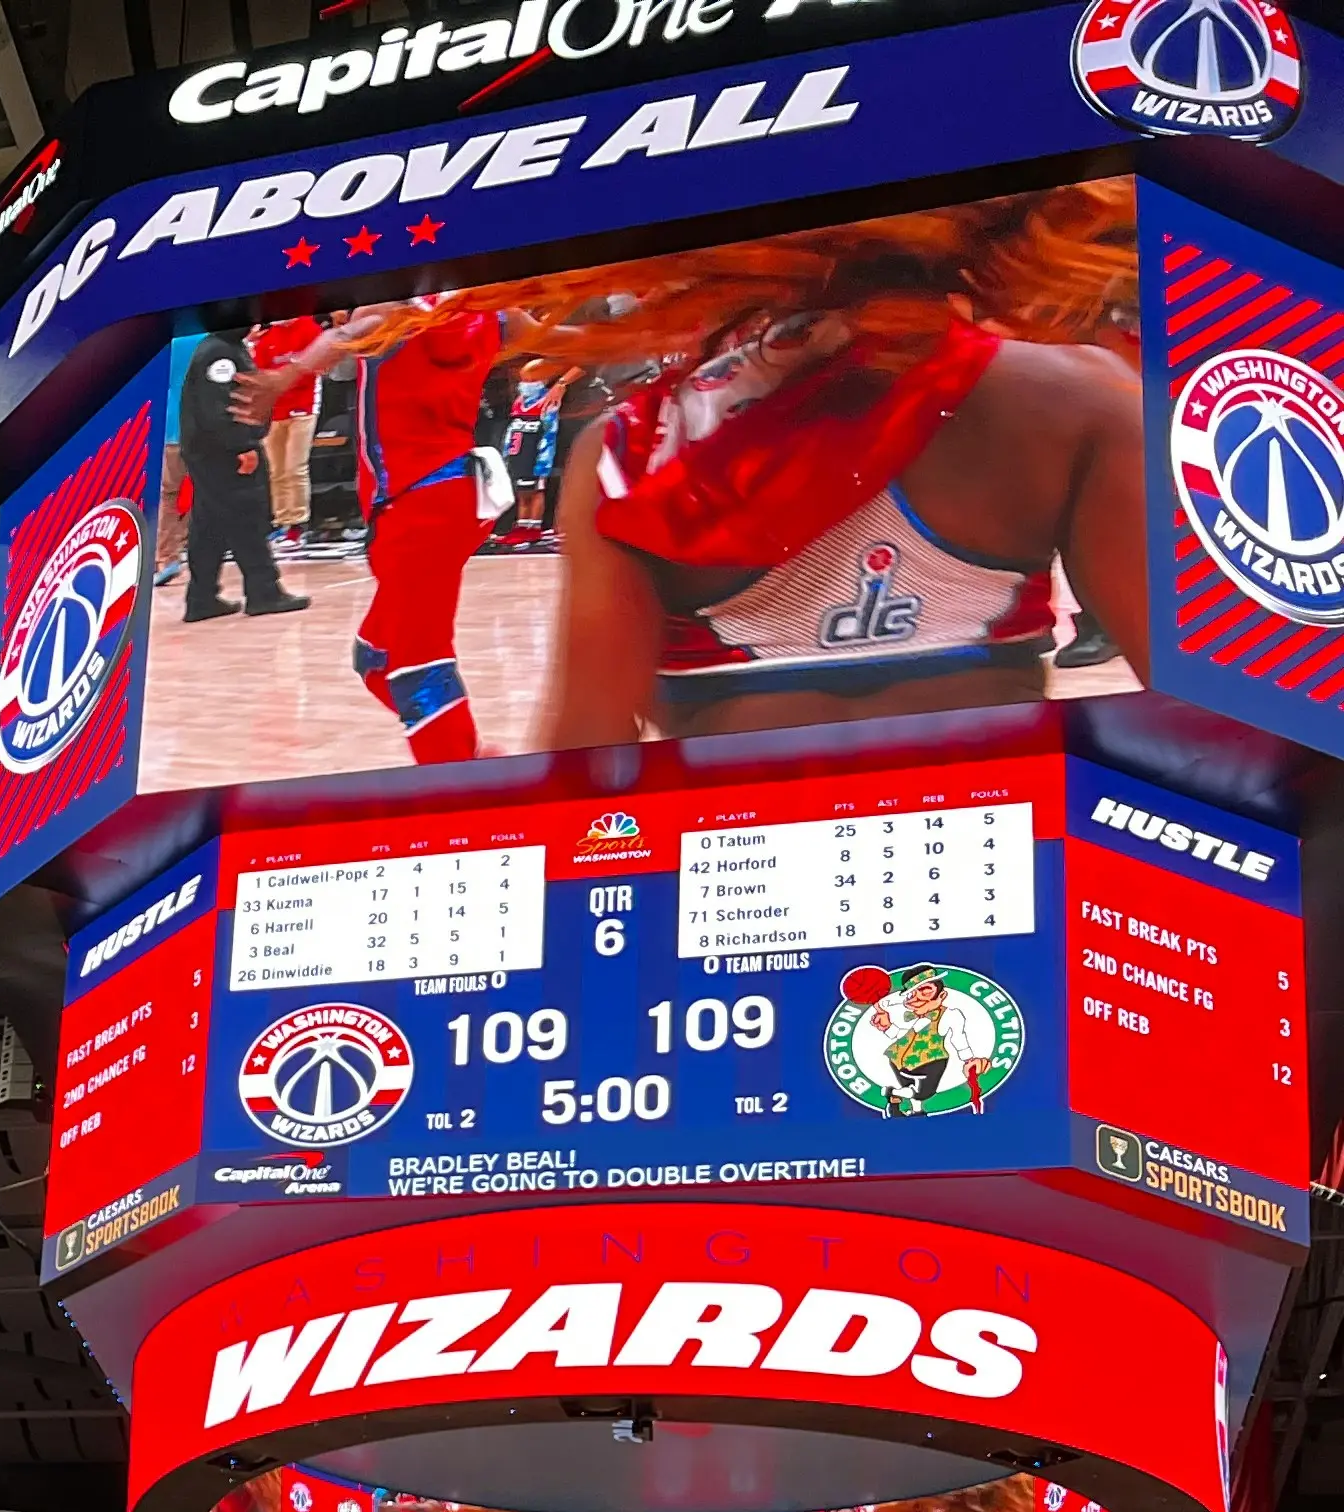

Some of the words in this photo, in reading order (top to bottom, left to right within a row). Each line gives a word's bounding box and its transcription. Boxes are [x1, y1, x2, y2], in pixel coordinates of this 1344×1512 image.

[1130, 90, 1274, 127] WIZARDS
[9, 218, 116, 360] DC
[118, 114, 588, 260] ABOVE
[580, 65, 860, 171] ALL
[19, 514, 121, 629] WASHINGTON
[11, 650, 106, 750] WIZARDS
[572, 849, 652, 865] WASHINGTON
[717, 832, 767, 850] Tatum
[833, 824, 857, 839] 25
[1091, 796, 1277, 883] HUSTLE
[716, 854, 778, 874] Horford
[266, 893, 313, 912] Kuzma
[589, 885, 633, 918] QTR
[716, 880, 767, 898] Brown
[833, 873, 857, 888] 34
[79, 874, 203, 980] HUSTLE
[265, 917, 314, 935] Harrell
[716, 903, 791, 923] Schroder
[1080, 900, 1124, 932] FAST
[1127, 916, 1182, 954] BREAK
[1186, 936, 1219, 966] PTS
[263, 942, 296, 958] Beal
[594, 918, 626, 956] 6
[715, 926, 808, 947] Richardson
[835, 923, 857, 939] 18
[261, 961, 333, 981] Dinwiddie
[725, 955, 764, 975] TEAM
[765, 951, 810, 972] FOULS
[1081, 948, 1118, 978] 2ND
[1122, 962, 1189, 1003] CHANCE
[1192, 985, 1215, 1011] FG
[414, 977, 448, 996] TEAM
[448, 974, 487, 994] FOULS
[65, 1040, 92, 1070] FAST
[93, 1017, 130, 1056] BREAK
[130, 1001, 154, 1034] PTS
[260, 1008, 391, 1052] WASHINGTON
[446, 1007, 569, 1067] 109
[647, 995, 775, 1055] 109
[828, 1002, 873, 1097] BOSTON
[967, 979, 1022, 1072] CELTICS
[1082, 996, 1113, 1023] OFF
[1116, 1008, 1151, 1037] REB
[1271, 1061, 1293, 1086] 12
[62, 1083, 85, 1109] 2ND
[86, 1057, 130, 1098] CHANCE
[541, 1074, 671, 1125] 5:00
[425, 1112, 453, 1131] TOL
[460, 1108, 476, 1128] 2
[734, 1095, 764, 1115] TOL
[771, 1093, 788, 1114] 2
[59, 1121, 80, 1150] OFF
[81, 1110, 102, 1139] REB
[270, 1108, 377, 1142] WIZARDS
[389, 1153, 499, 1176] BRADLEY
[506, 1150, 577, 1173] BEAL!
[389, 1174, 467, 1197] WE'RE
[471, 1171, 559, 1193] GOING
[564, 1168, 601, 1190] TO
[607, 1164, 713, 1188] DOUBLE
[718, 1157, 867, 1184] OVERTIME!
[1144, 1139, 1229, 1184] CAESARS
[86, 1187, 143, 1228] CAESARS
[284, 1180, 341, 1195] Arena
[1145, 1160, 1288, 1233] SPORTSBOOK
[86, 1185, 181, 1246] SPORTSBOOK
[202, 1279, 1040, 1431] WIZARDS
